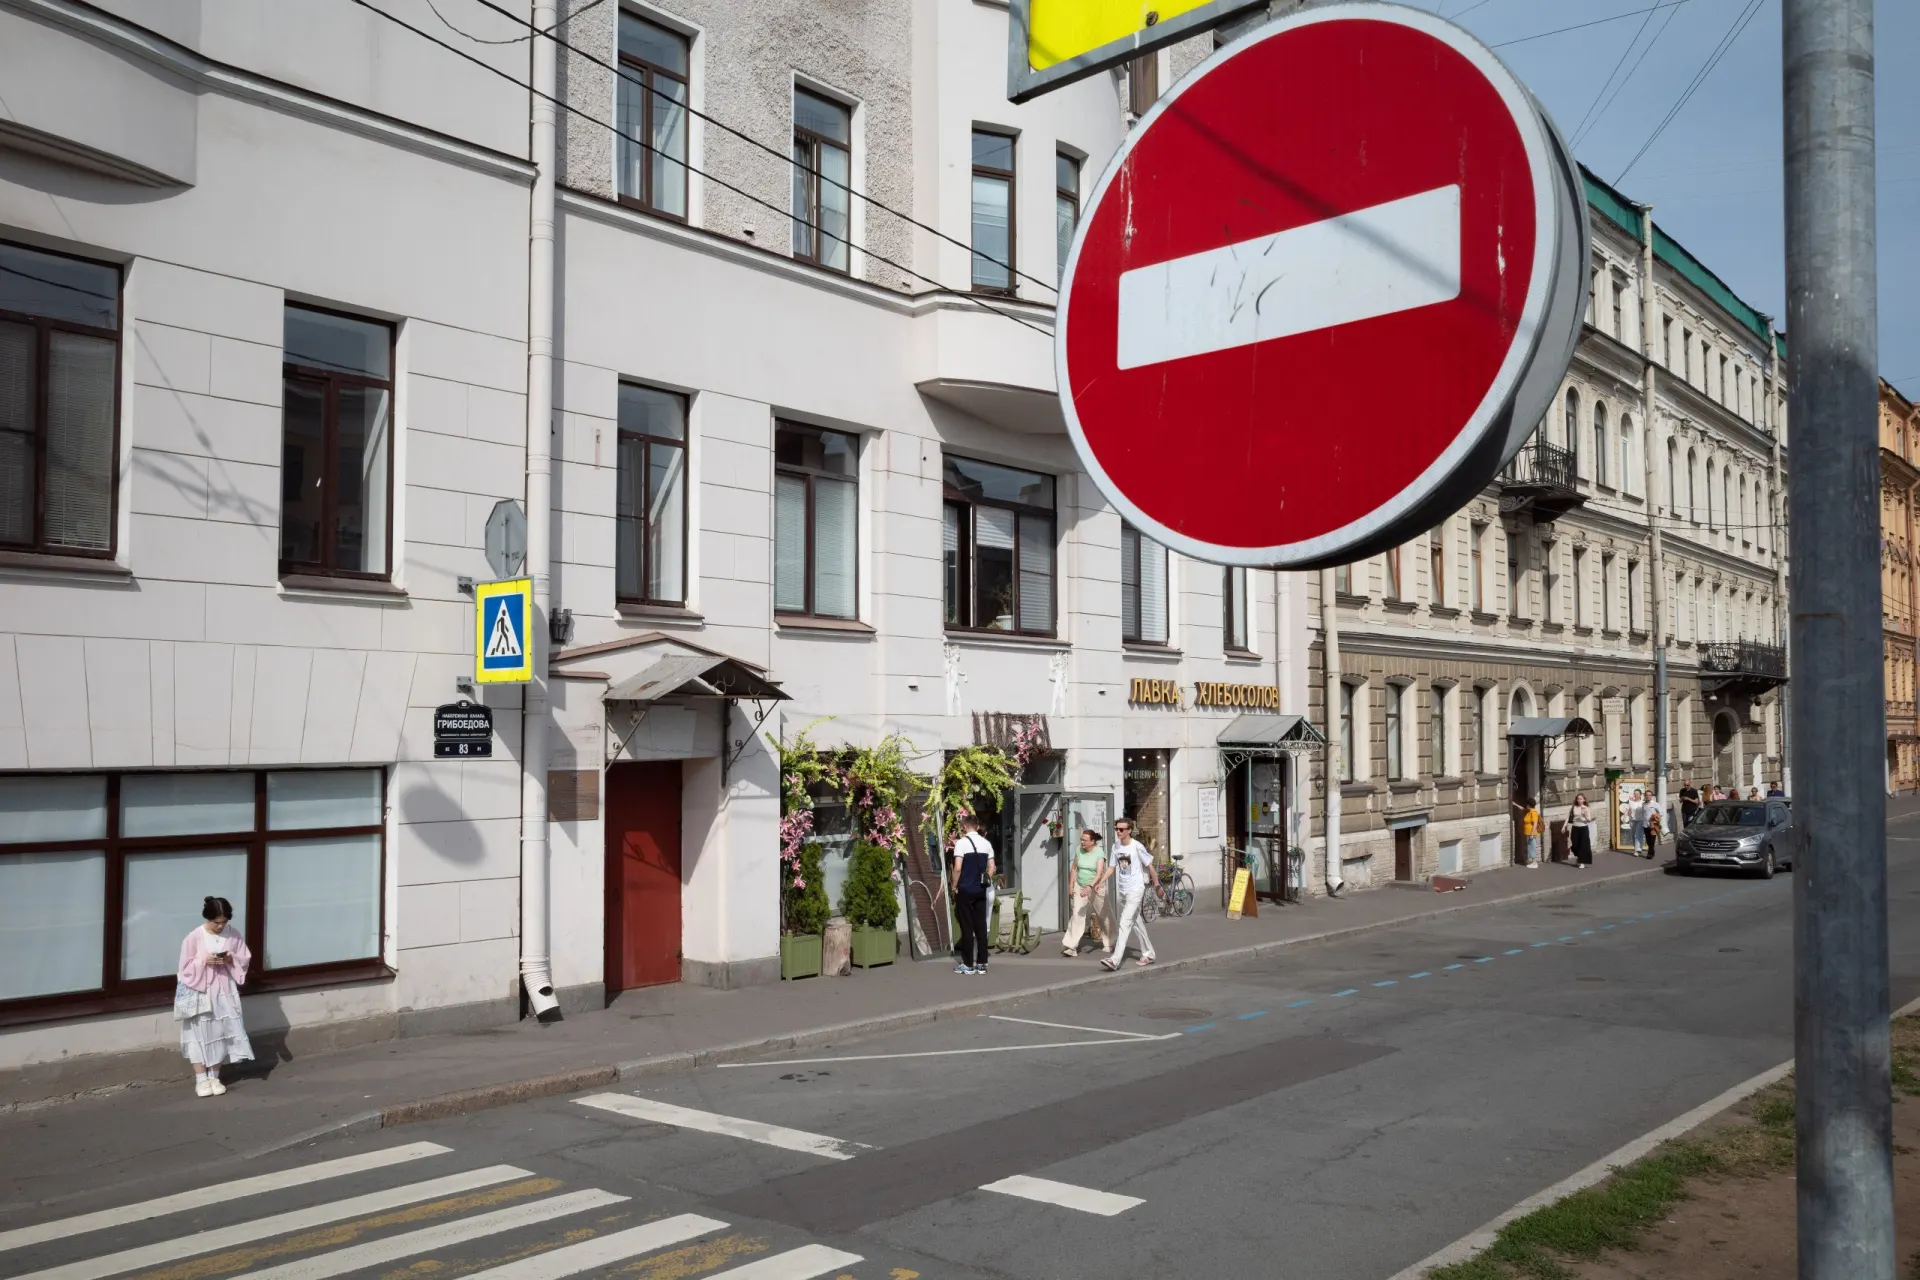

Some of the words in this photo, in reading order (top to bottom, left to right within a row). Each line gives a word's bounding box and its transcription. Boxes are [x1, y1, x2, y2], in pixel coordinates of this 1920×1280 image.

[1131, 678, 1179, 704] ЛАВКА
[1196, 681, 1279, 708] ХЛЕБОСОЛОВ
[438, 720, 490, 730] ГРИБОЕДОВА
[459, 744, 468, 754] 83
